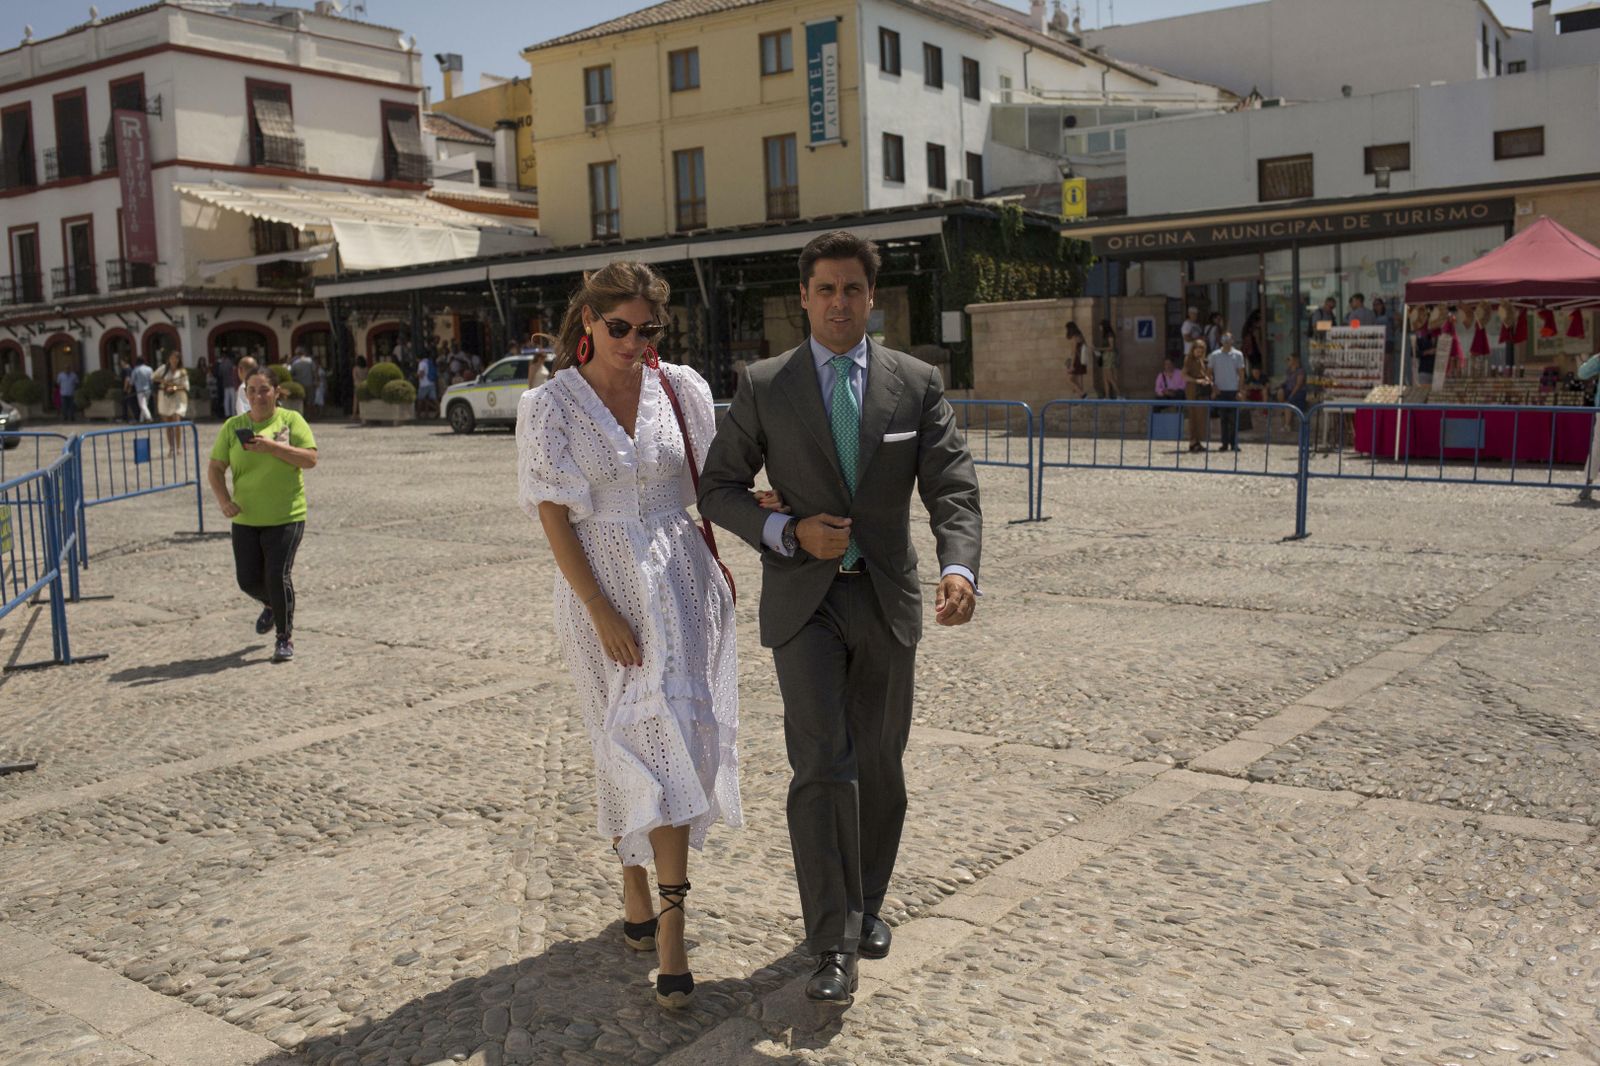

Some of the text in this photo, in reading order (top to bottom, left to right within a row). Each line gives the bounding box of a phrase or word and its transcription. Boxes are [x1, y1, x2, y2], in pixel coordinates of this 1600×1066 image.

[809, 52, 825, 134] HOTEL
[825, 55, 838, 127] ACINIPO
[1107, 203, 1489, 250] OFICINA MUNICIPAL DE TURISMO
